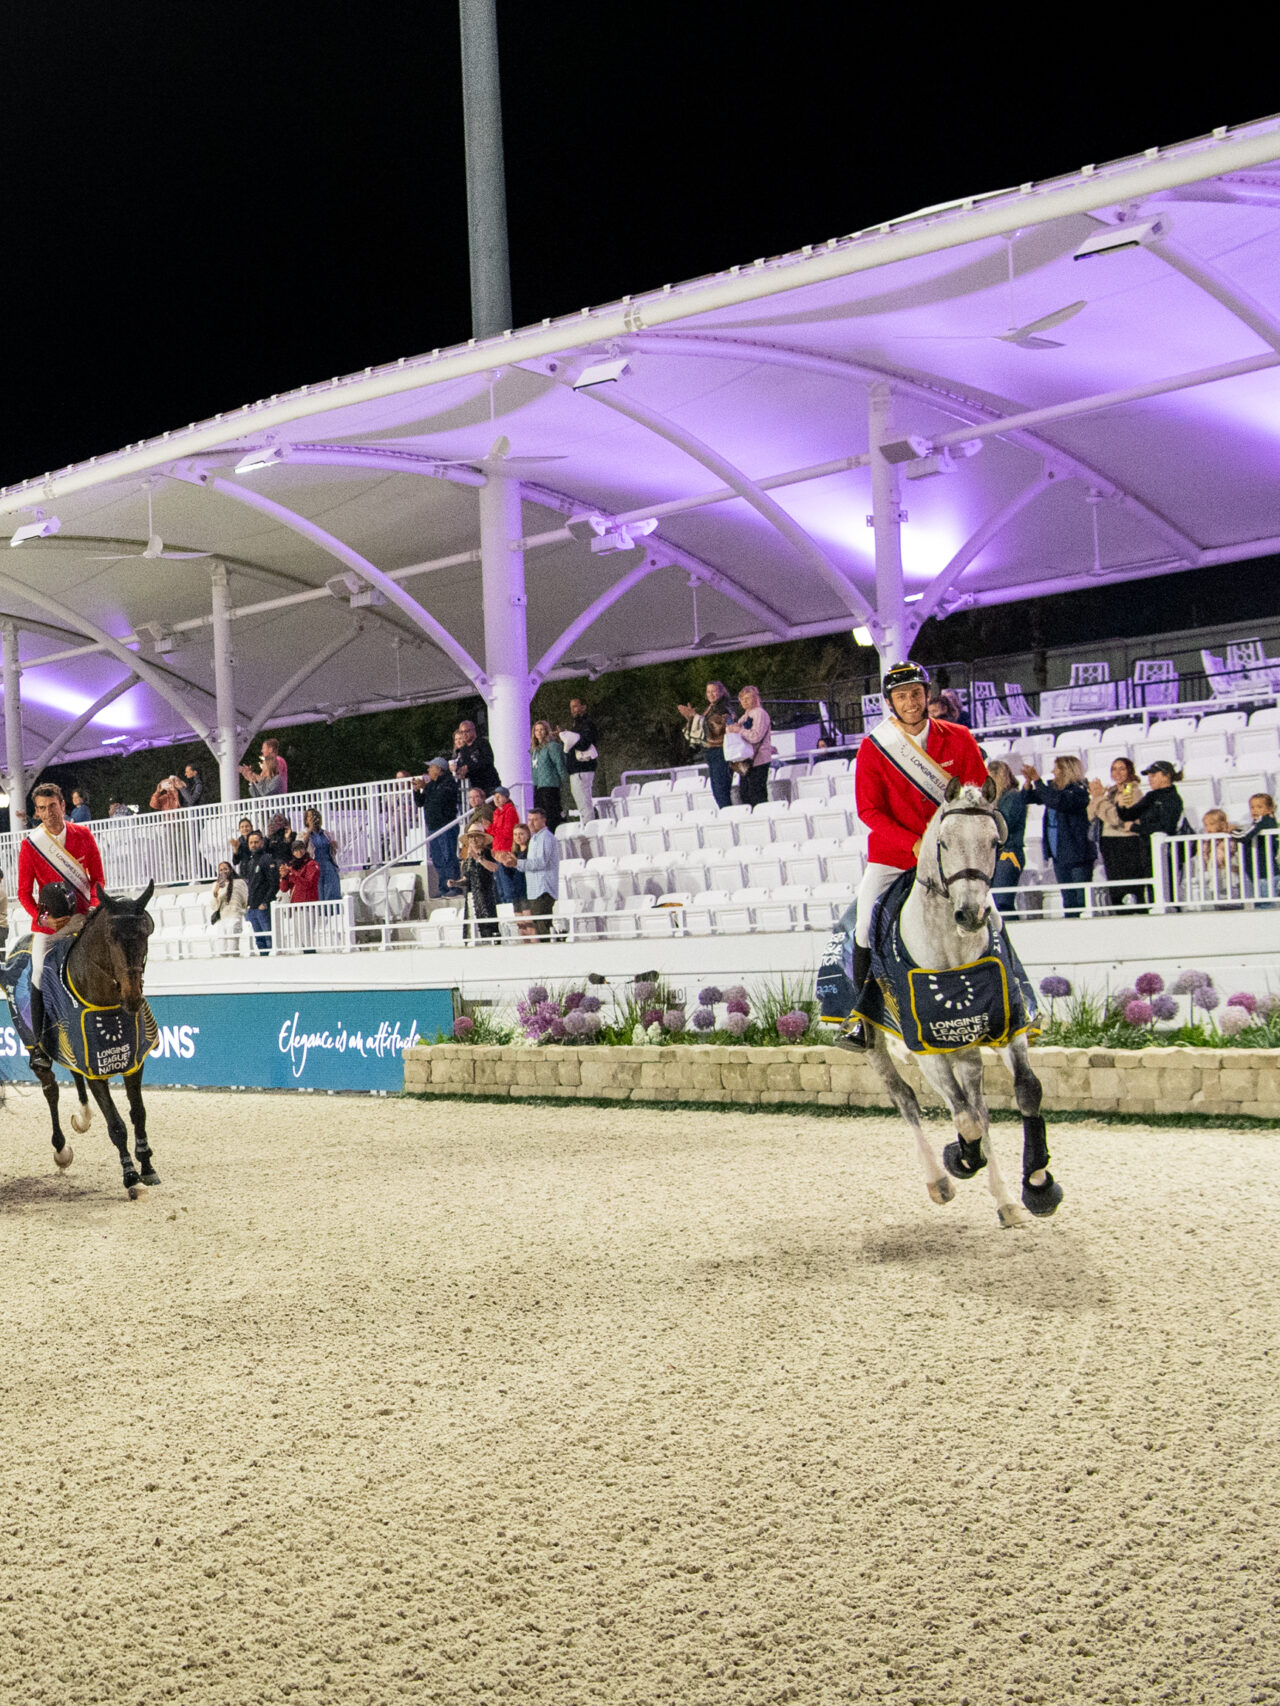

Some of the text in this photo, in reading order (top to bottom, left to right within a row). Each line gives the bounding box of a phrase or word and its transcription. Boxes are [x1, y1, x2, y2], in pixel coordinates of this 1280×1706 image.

[929, 1012, 989, 1030] LONGINES
[278, 1011, 334, 1078] Elegance
[335, 1021, 348, 1053] is
[348, 1030, 368, 1058] an
